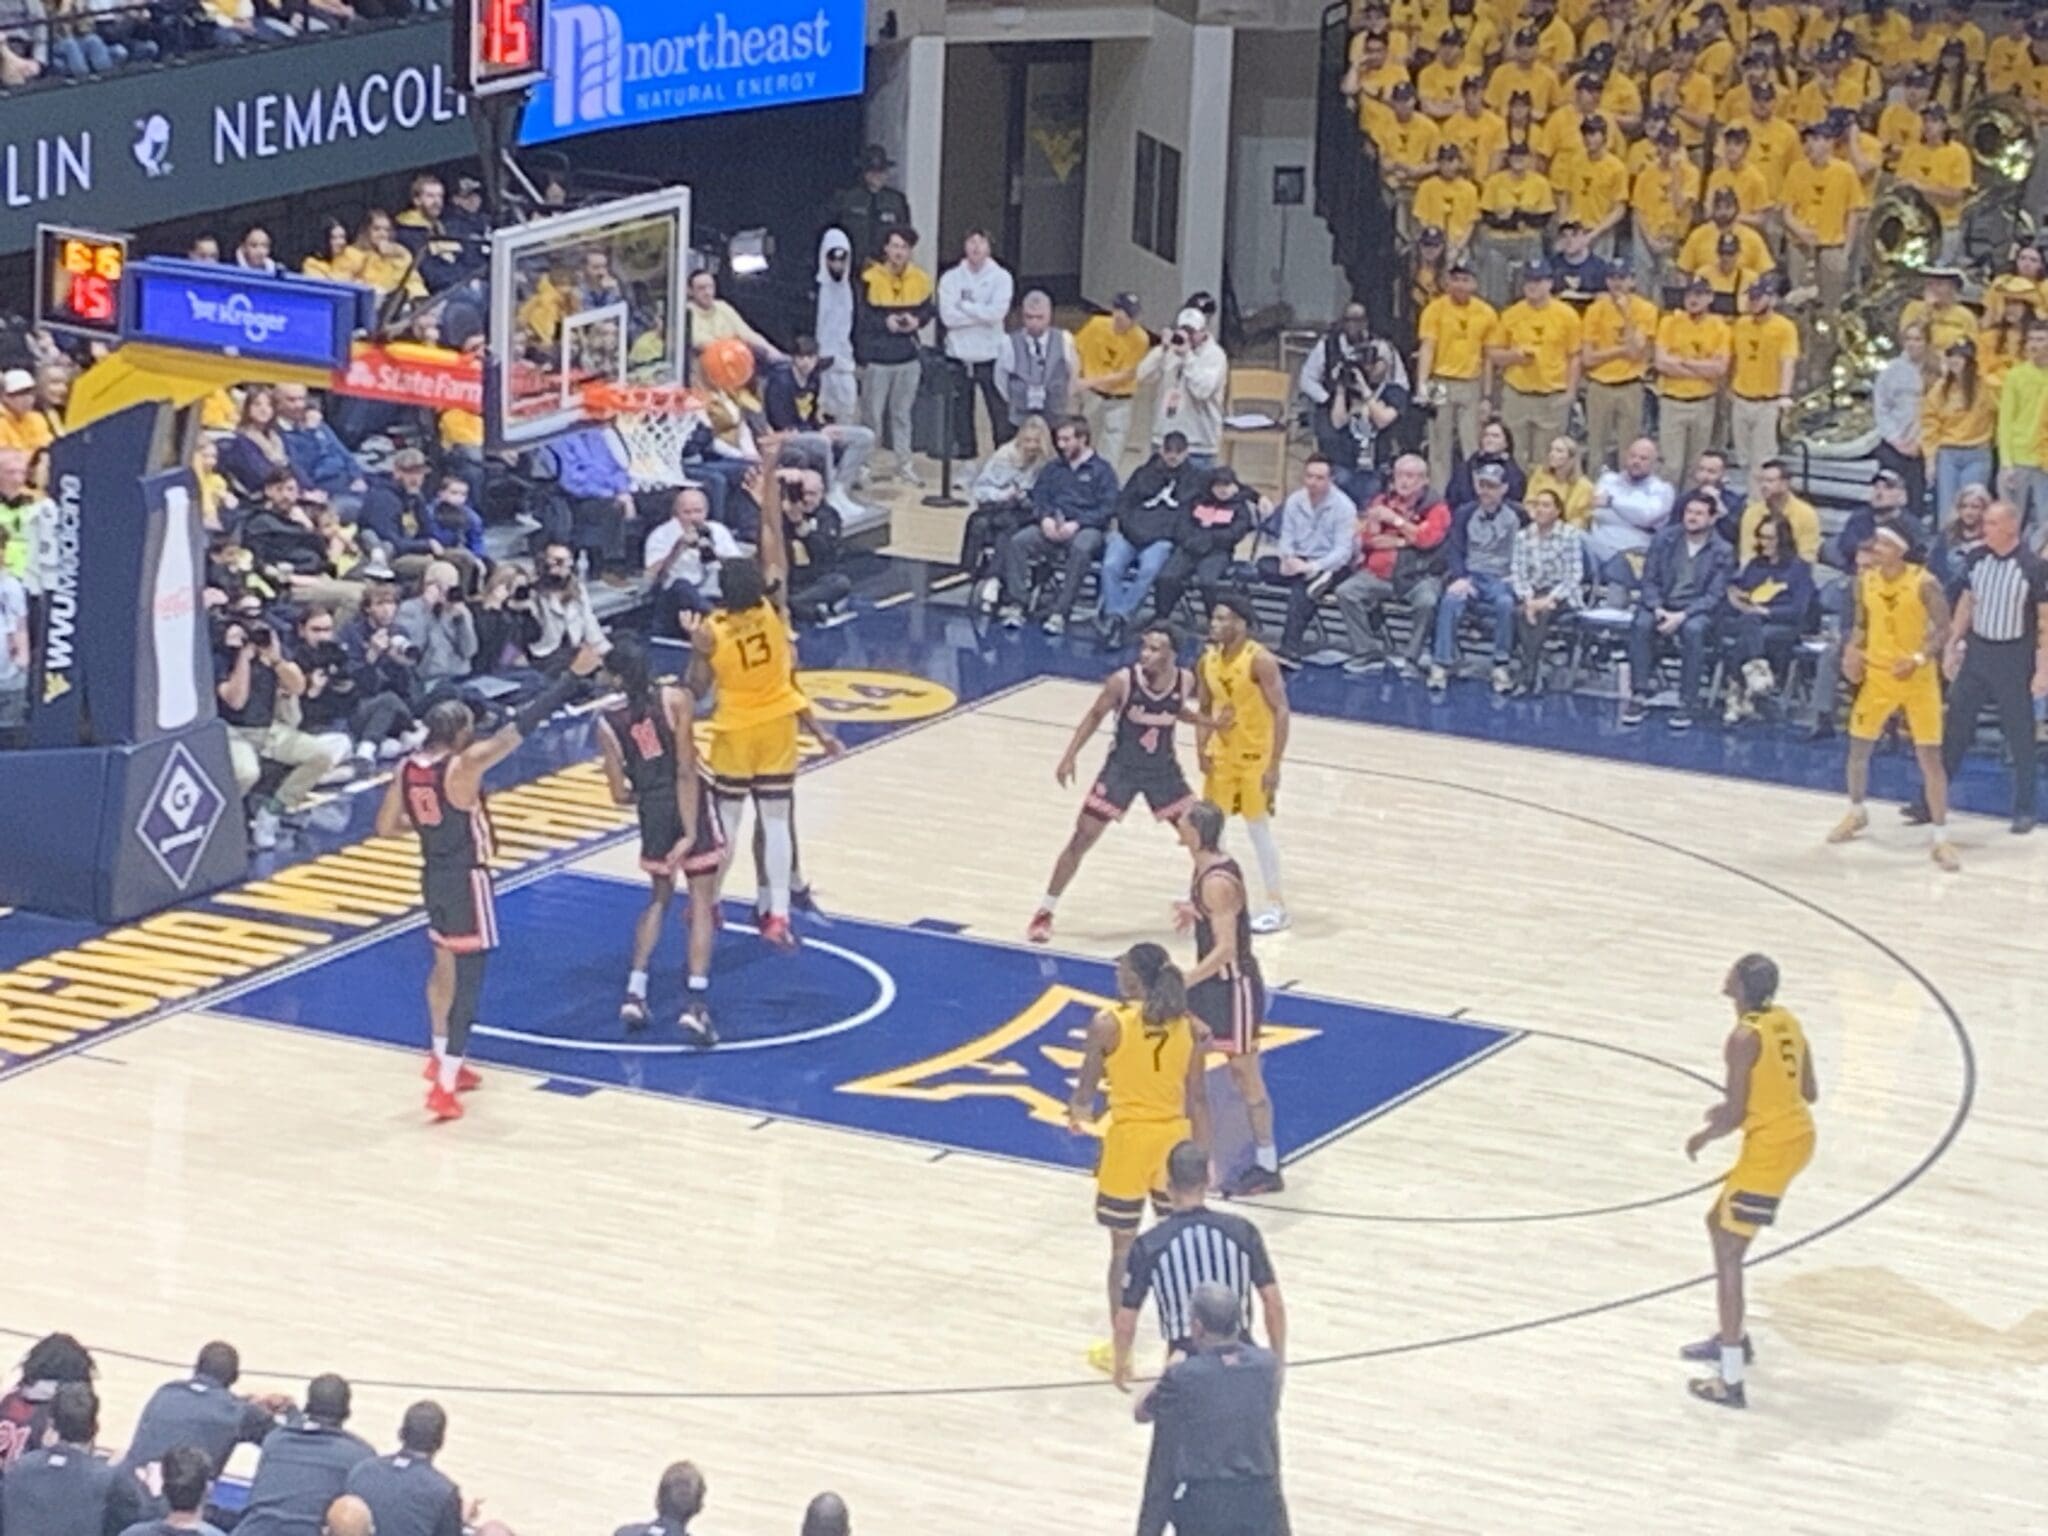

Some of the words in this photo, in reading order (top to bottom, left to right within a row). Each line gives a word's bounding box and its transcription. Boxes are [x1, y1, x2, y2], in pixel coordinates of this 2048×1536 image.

[624, 8, 832, 81] northeast
[635, 83, 725, 111] NATURAL
[736, 71, 817, 99] ENERGY
[7, 131, 90, 206] LIN
[736, 630, 772, 672] 13
[1144, 1030, 1169, 1073] 7
[1780, 1039, 1798, 1078] 5
